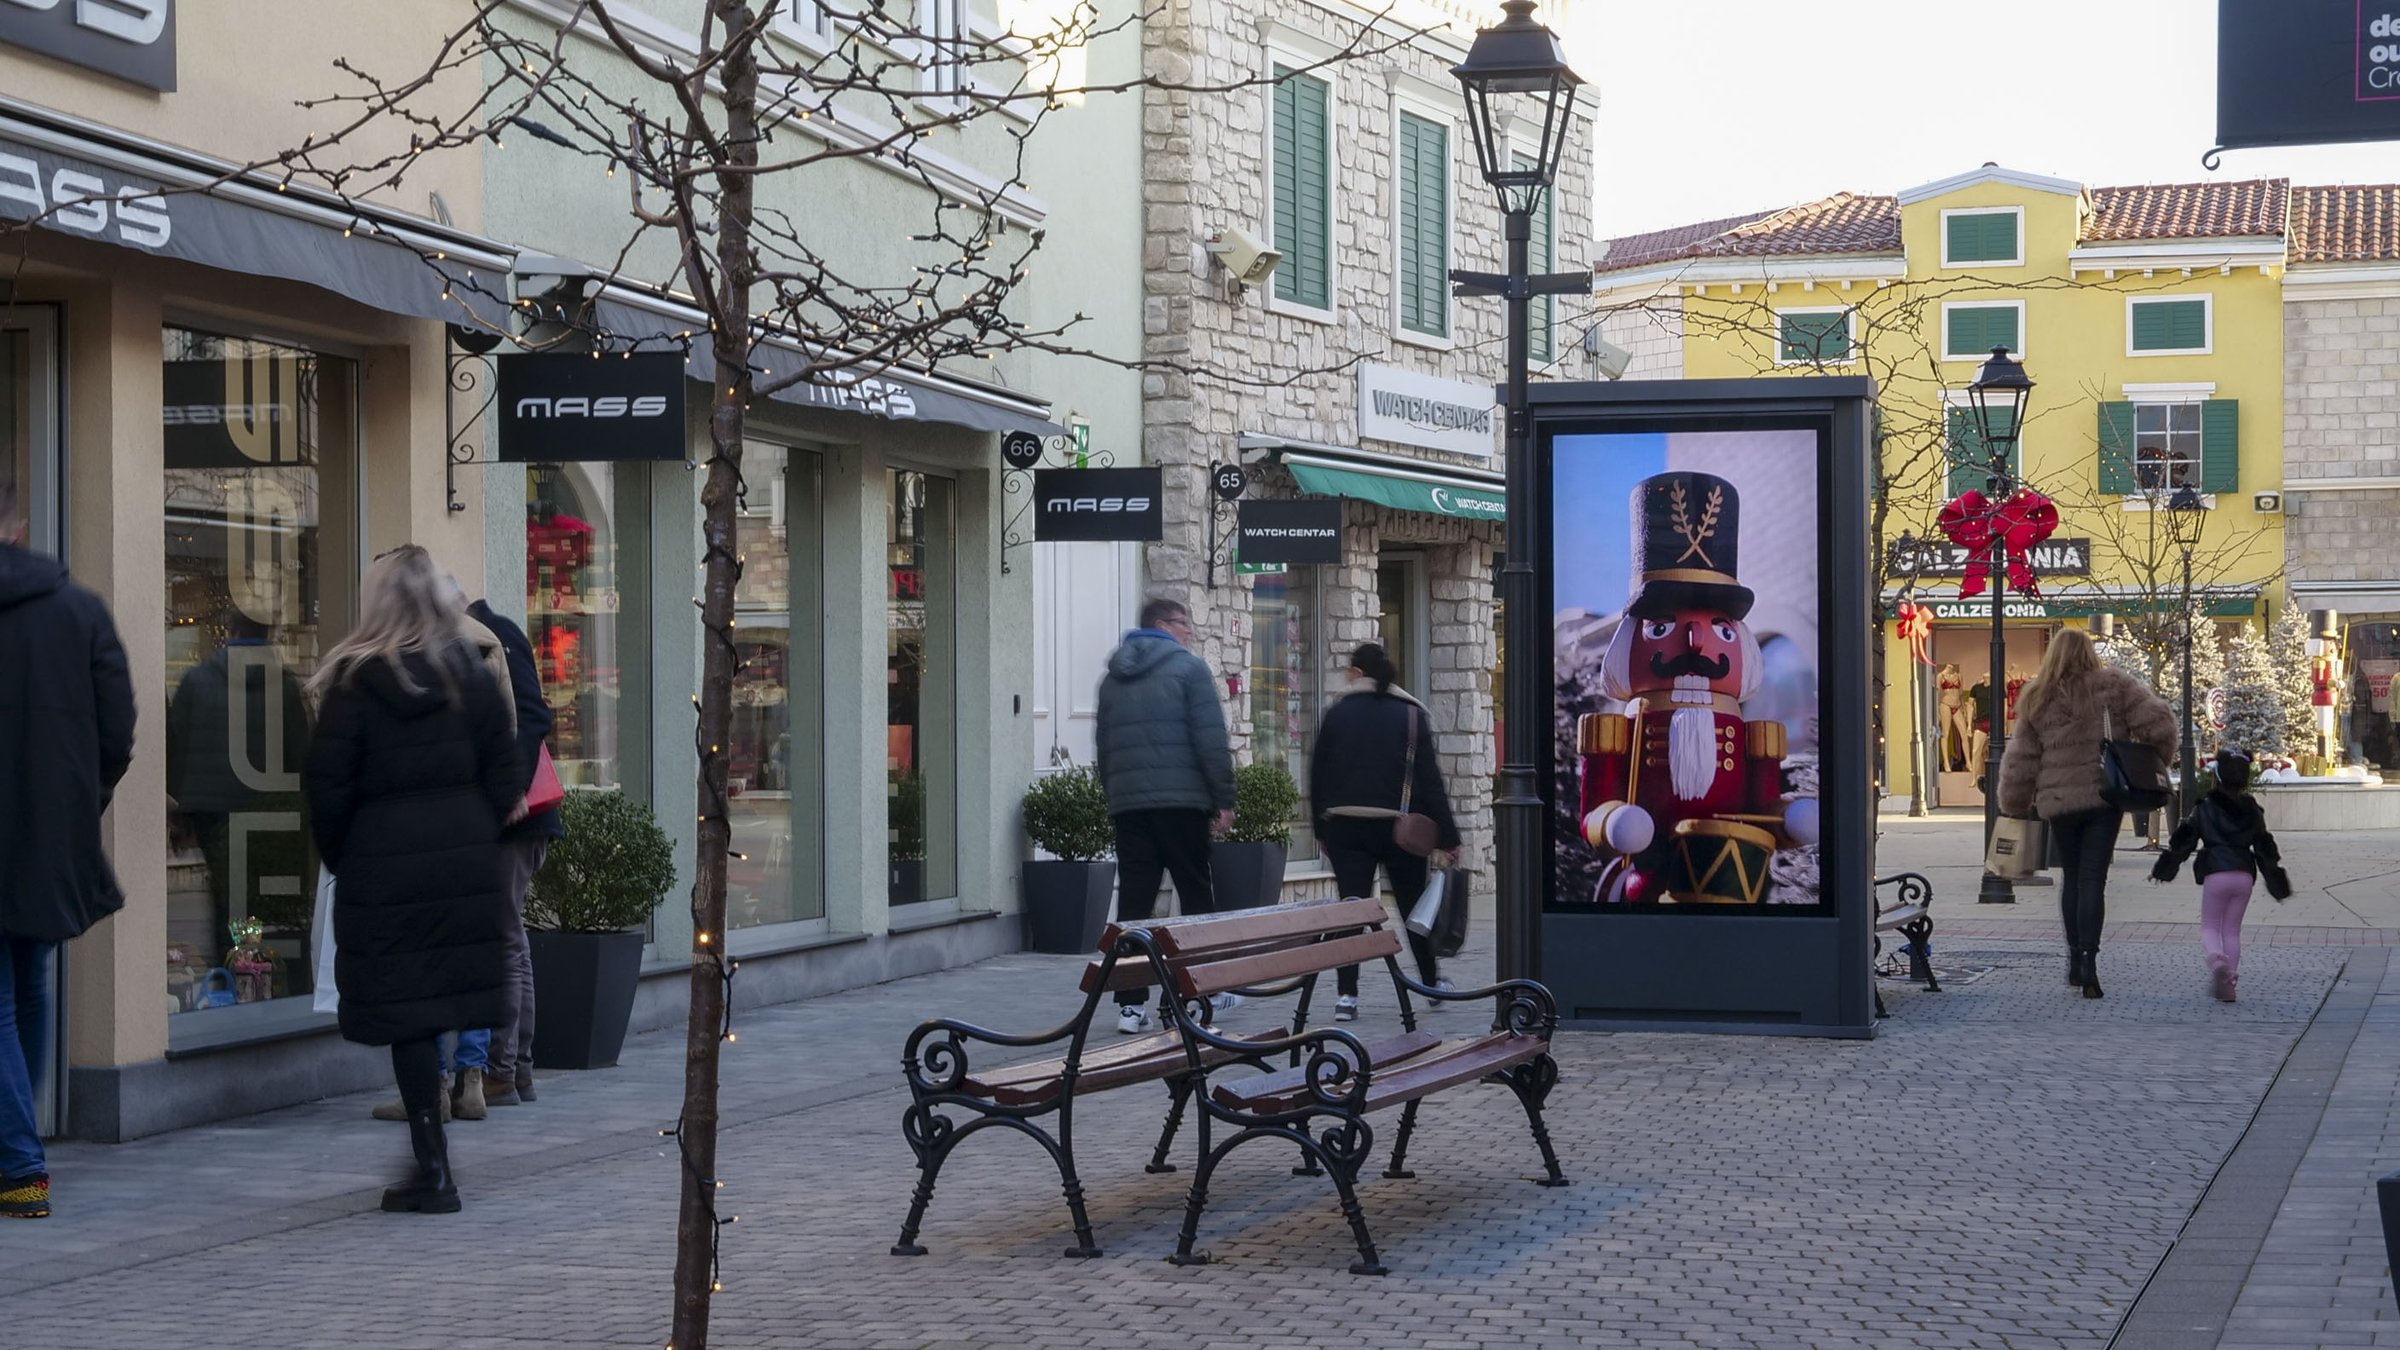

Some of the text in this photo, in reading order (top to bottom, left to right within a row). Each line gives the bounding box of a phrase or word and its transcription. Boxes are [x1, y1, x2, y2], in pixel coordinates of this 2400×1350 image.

[2368, 66, 2400, 88] Cr
[516, 396, 667, 418] MASS
[1010, 440, 1036, 457] 66
[1219, 473, 1240, 488] 65
[1047, 497, 1150, 512] MASS
[1482, 500, 1506, 513] CENTA
[1245, 528, 1335, 537] WATCH CENTAR
[1898, 547, 2082, 571] CALZNIA
[1936, 604, 2046, 618] CALZEONIA
